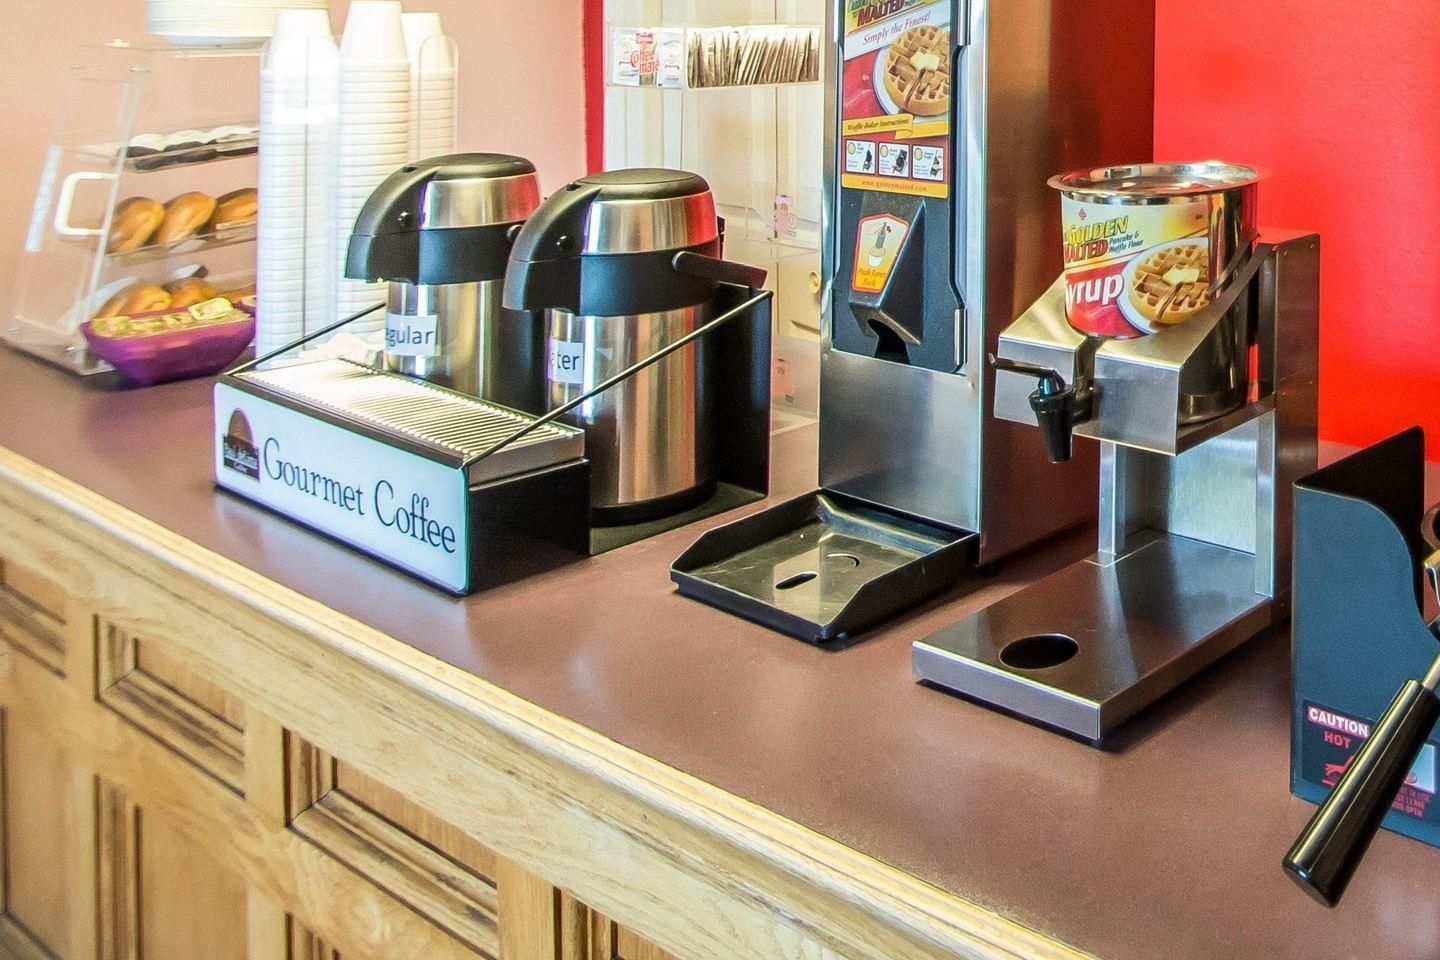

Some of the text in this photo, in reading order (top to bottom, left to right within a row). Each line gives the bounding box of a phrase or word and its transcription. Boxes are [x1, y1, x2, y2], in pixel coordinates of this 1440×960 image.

[863, 27, 889, 46] Simply
[891, 21, 902, 36] the
[848, 122, 863, 132] Waffle
[1068, 215, 1128, 246] GOLDEN
[264, 437, 456, 553] Gourmet Coffee
[1308, 707, 1370, 737] CAUTION
[1324, 731, 1351, 749] HOT
